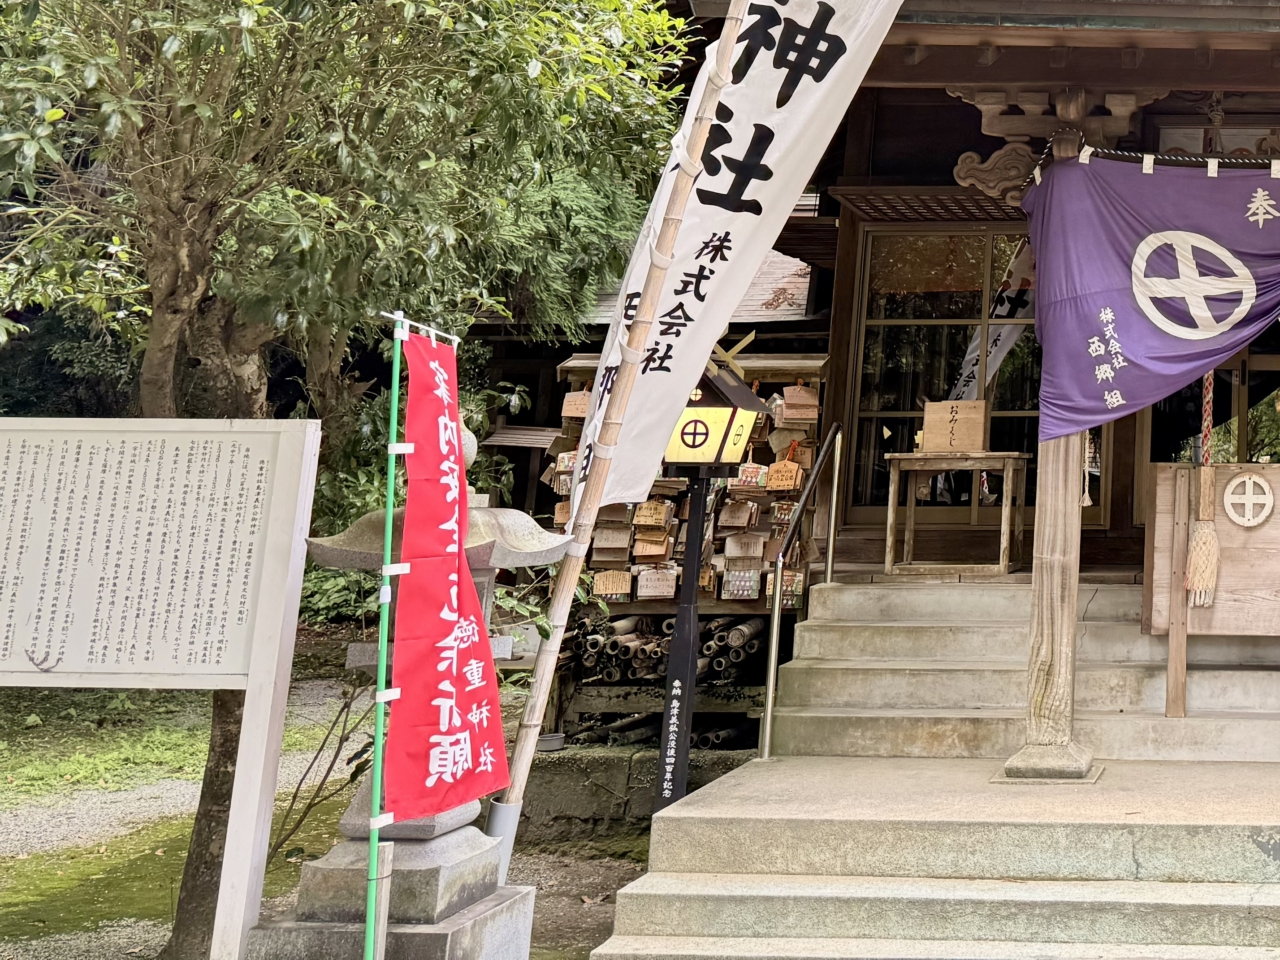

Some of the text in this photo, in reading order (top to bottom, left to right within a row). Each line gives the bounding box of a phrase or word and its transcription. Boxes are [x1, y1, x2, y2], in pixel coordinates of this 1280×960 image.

[640, 231, 732, 375] 株式会社
[1099, 307, 1128, 369] 株式会社
[1087, 336, 1127, 409] 西郷組
[949, 405, 959, 447] おみくじ
